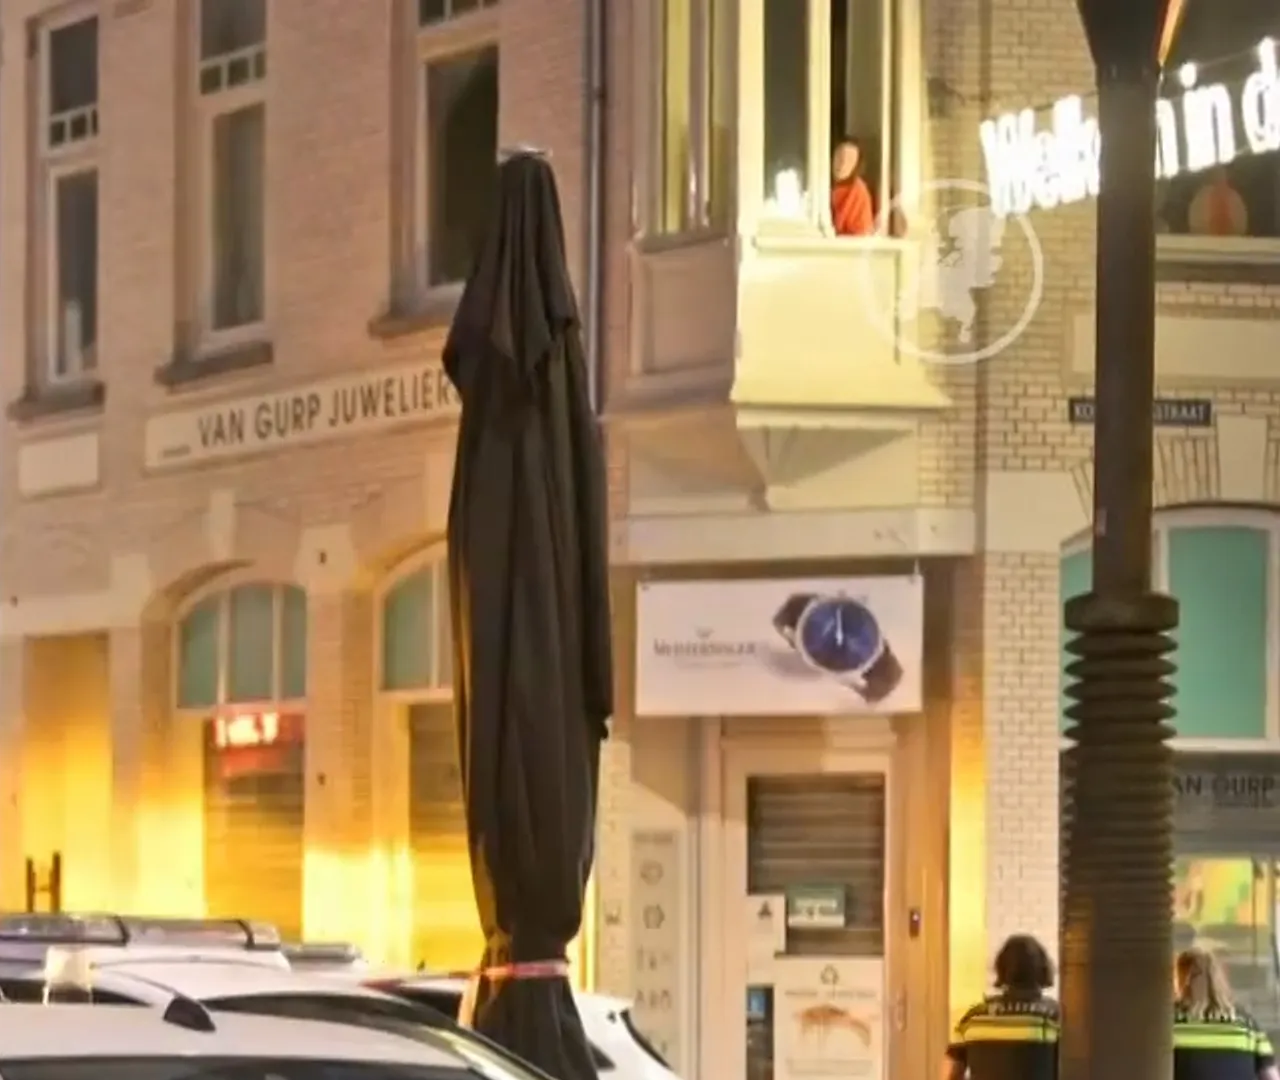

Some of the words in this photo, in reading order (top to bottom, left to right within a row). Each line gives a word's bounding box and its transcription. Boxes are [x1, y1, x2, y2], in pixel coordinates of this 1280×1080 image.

[1179, 62, 1236, 172] in
[198, 407, 244, 448] VAN
[253, 393, 321, 440] GURP
